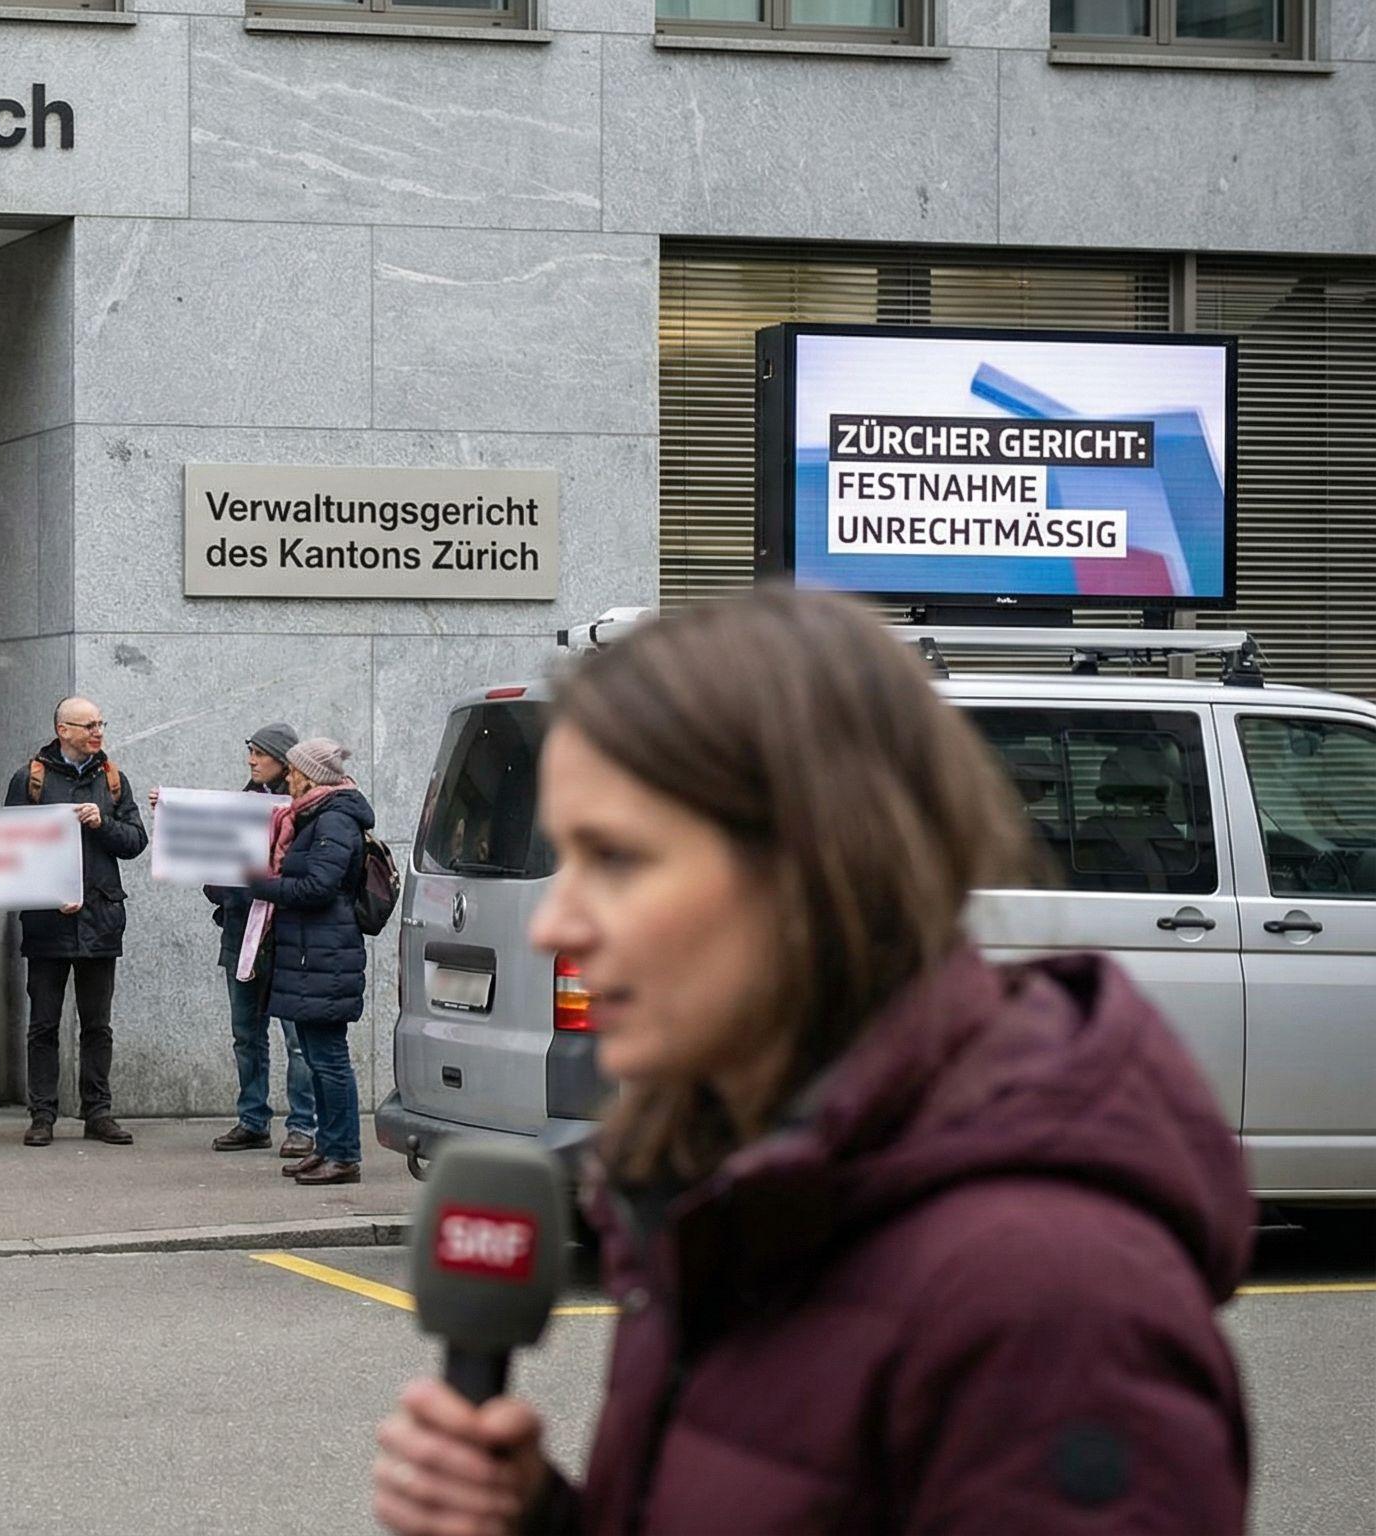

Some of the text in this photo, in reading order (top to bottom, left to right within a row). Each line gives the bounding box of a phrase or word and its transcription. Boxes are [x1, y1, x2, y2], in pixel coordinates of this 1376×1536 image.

[837, 419, 1146, 460] ZÜRCHER GERICHT:
[838, 471, 1037, 503] FESTNAHME
[205, 491, 539, 533] Verwaltungsgericht
[838, 512, 1116, 548] UNRECHTMÄSSIG
[206, 537, 539, 571] des Kantons Zürich
[438, 1214, 534, 1269] SRF
